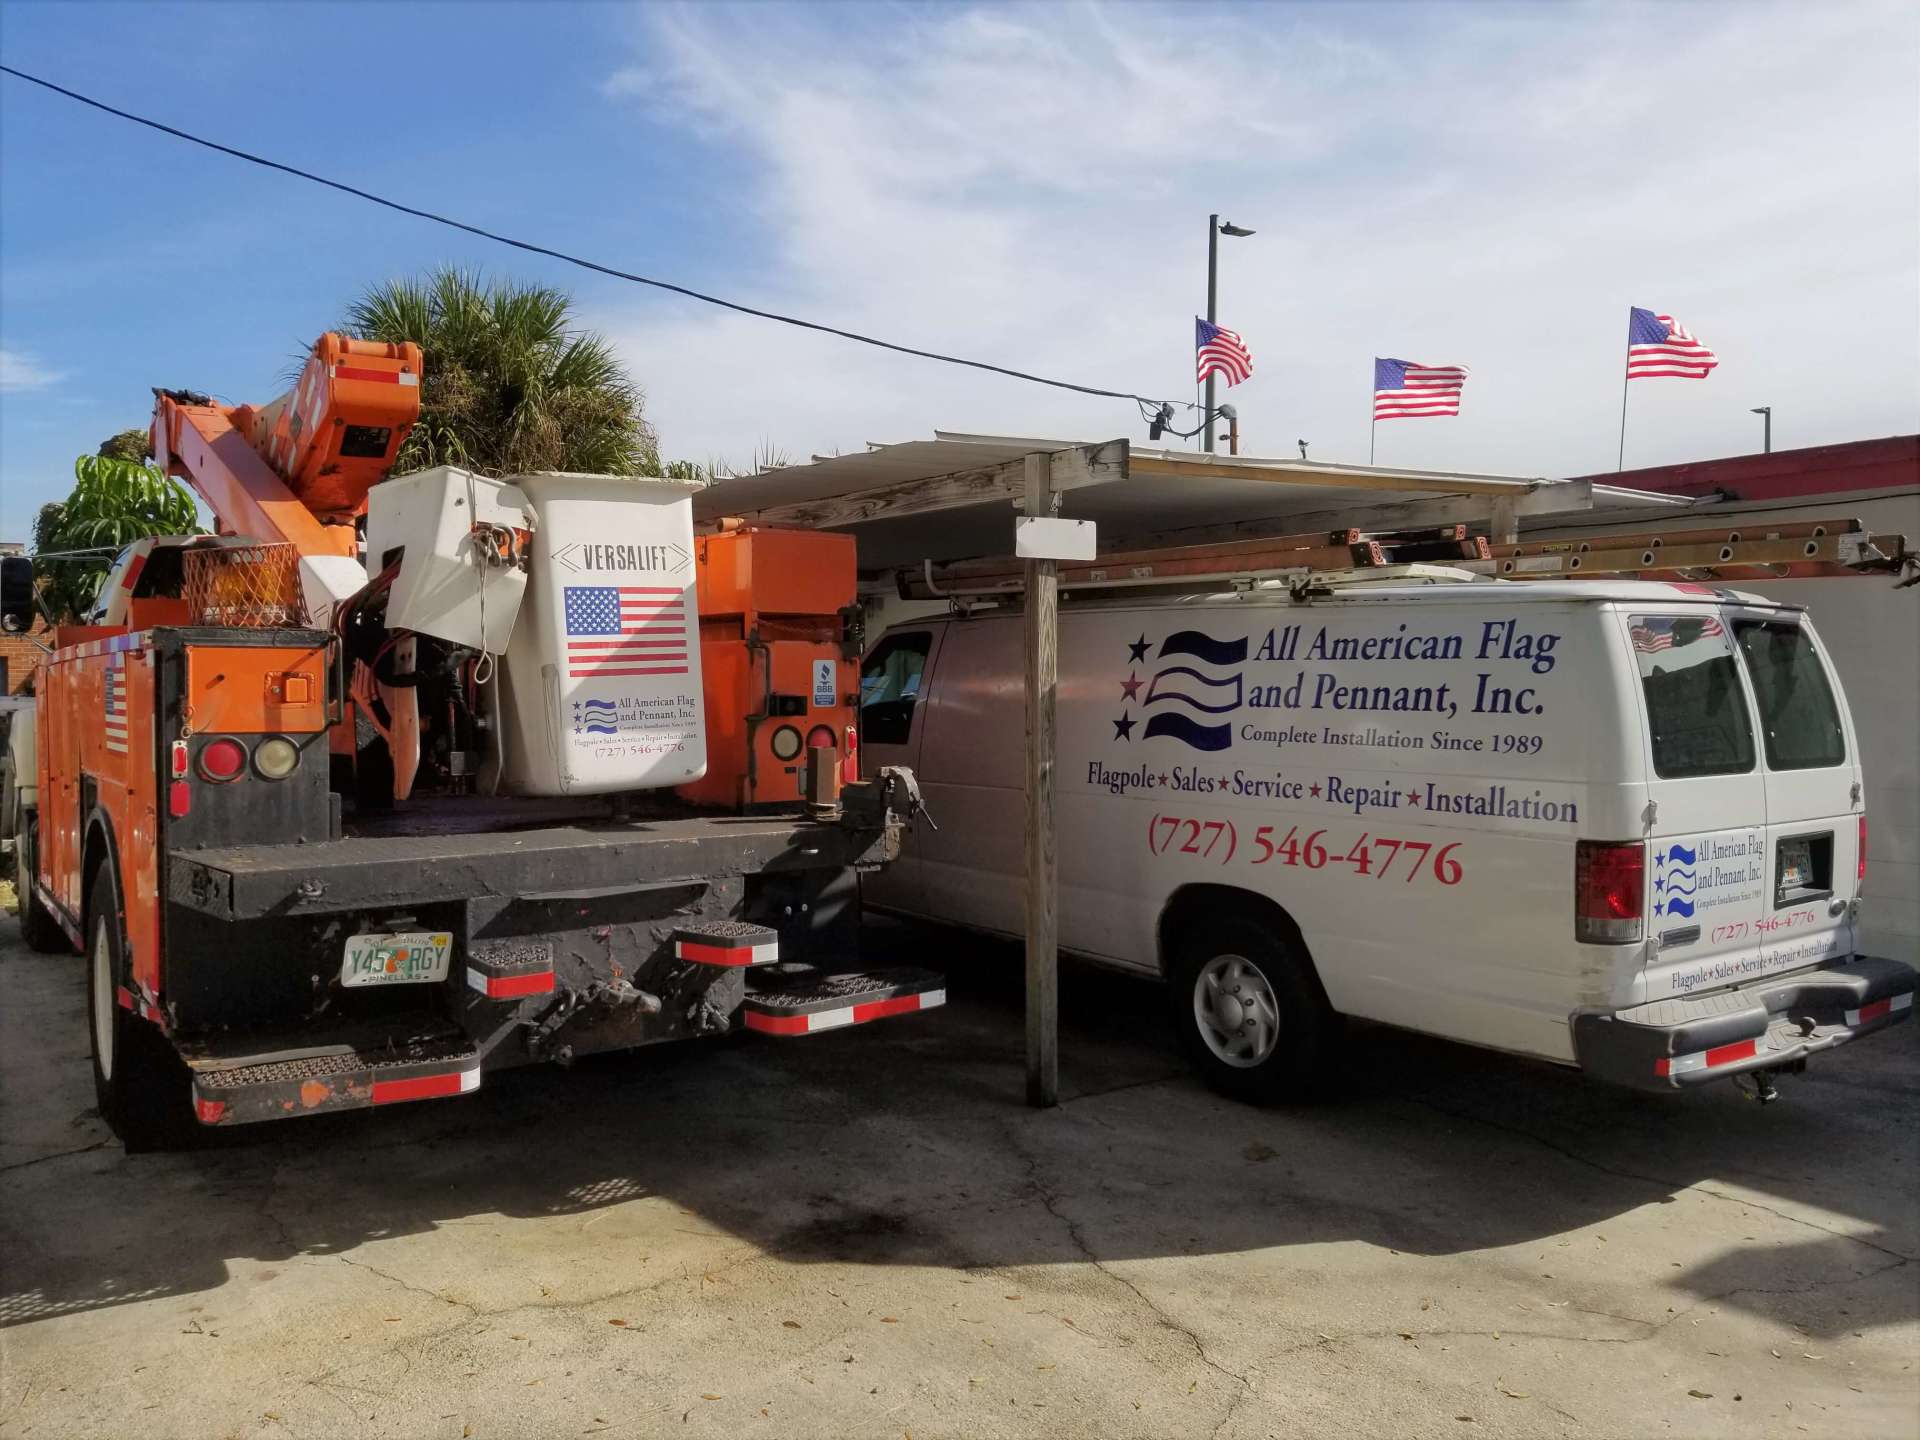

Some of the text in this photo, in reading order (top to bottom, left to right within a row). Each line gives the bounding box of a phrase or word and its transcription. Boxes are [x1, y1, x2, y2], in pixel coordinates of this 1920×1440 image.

[583, 544, 666, 571] VERSALIFT
[1253, 618, 1560, 674] All American Flag
[618, 695, 696, 709] All American Flag
[1248, 671, 1544, 719] and Pennant, Inc.
[620, 708, 696, 721] and Pennant, Inc.
[595, 742, 685, 759] (727) 546-4776
[1240, 724, 1543, 756] Complete Installation Since 1989
[1087, 760, 1579, 824] Flagpole Sales Service Repair Installation
[1148, 812, 1464, 886] (727) 546-4776
[1697, 834, 1763, 862] All American Flag
[1698, 867, 1713, 889] and
[1715, 866, 1747, 887] Pennant,
[1749, 861, 1762, 881] Inc.
[1711, 911, 1815, 945] (727) 546-4776
[369, 974, 422, 983] PINELLAS
[1672, 969, 1707, 992] Flagpole
[1714, 963, 1734, 980] Sales
[1741, 956, 1769, 975] Service
[1773, 949, 1796, 967] Repair
